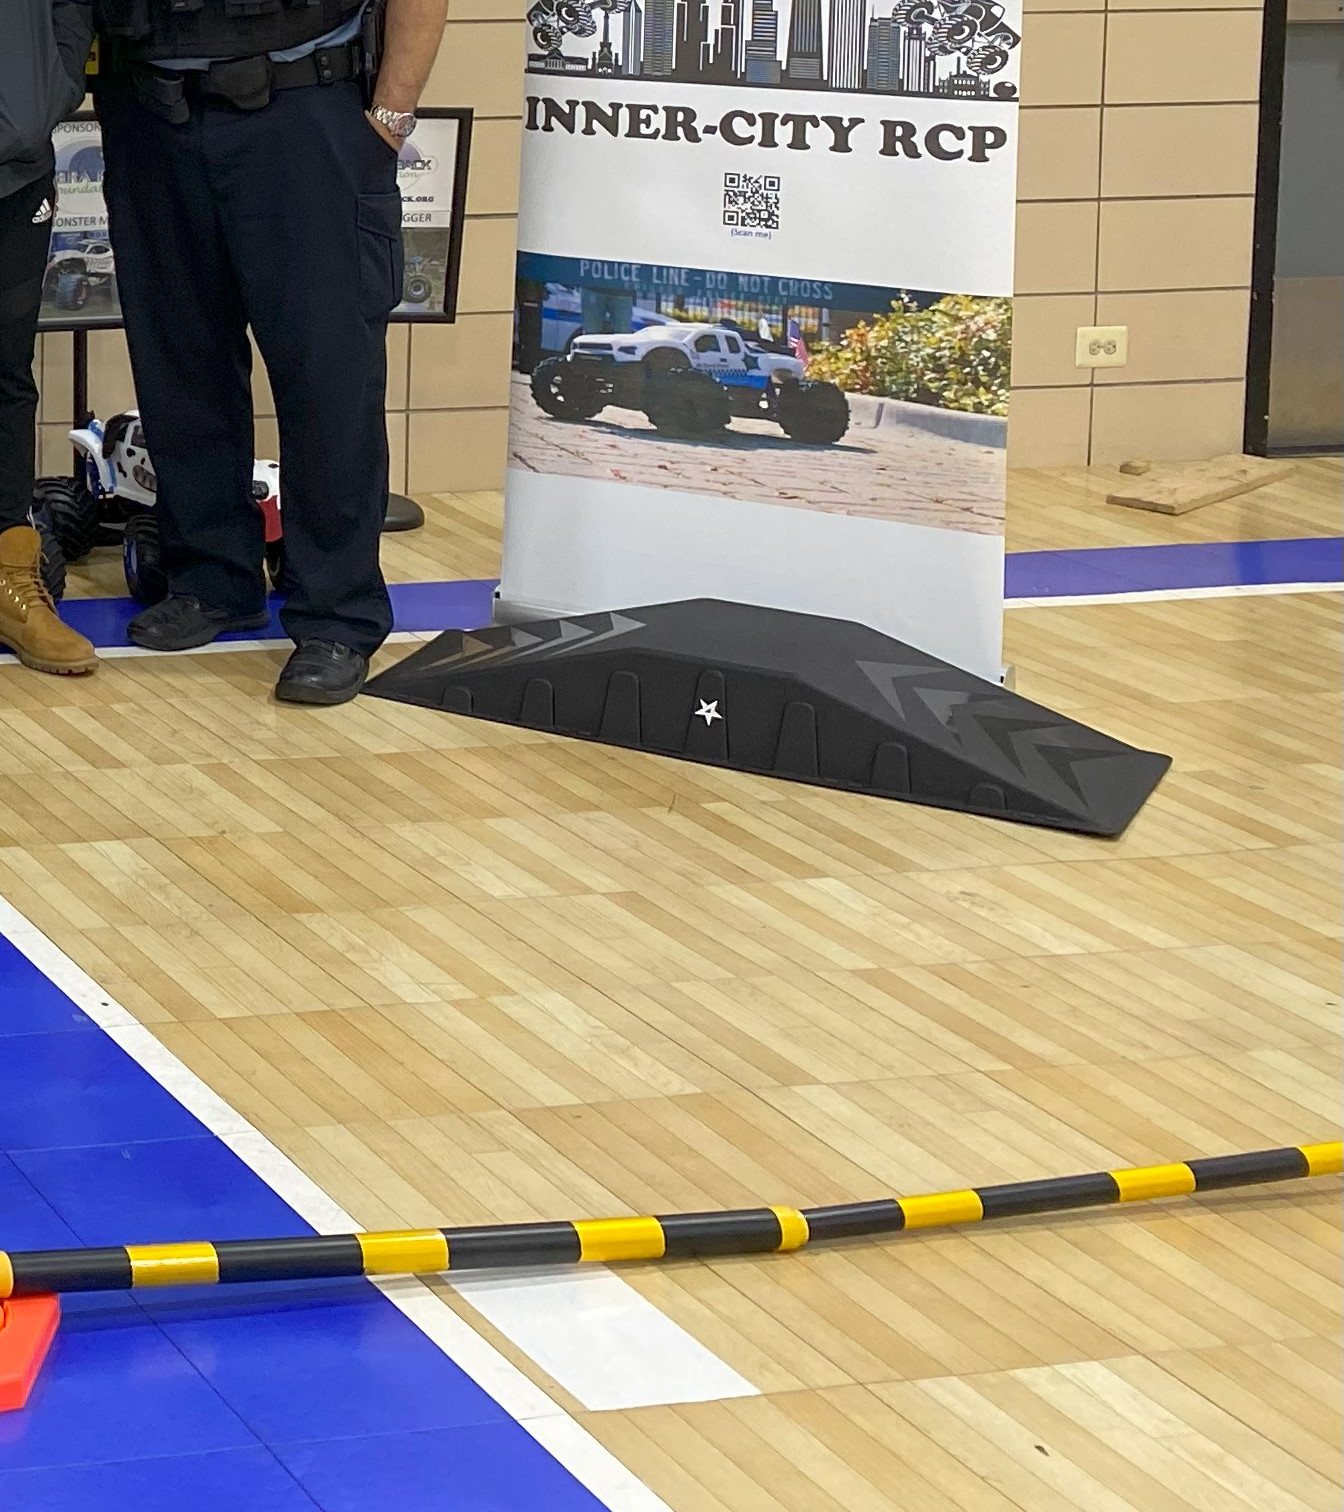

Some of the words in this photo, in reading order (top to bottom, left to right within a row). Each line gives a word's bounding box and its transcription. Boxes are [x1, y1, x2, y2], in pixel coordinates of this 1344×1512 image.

[524, 95, 867, 155] INNER-CITY
[878, 118, 1008, 164] RCP
[55, 216, 97, 228] ONSTER
[402, 212, 432, 223] GGER
[730, 227, 753, 238] (Scan
[755, 230, 772, 240] me)
[579, 259, 641, 282] POLICE
[652, 266, 690, 287] LINE
[705, 270, 727, 289] DO
[738, 274, 771, 295] NOT
[778, 279, 834, 301] CROSS
